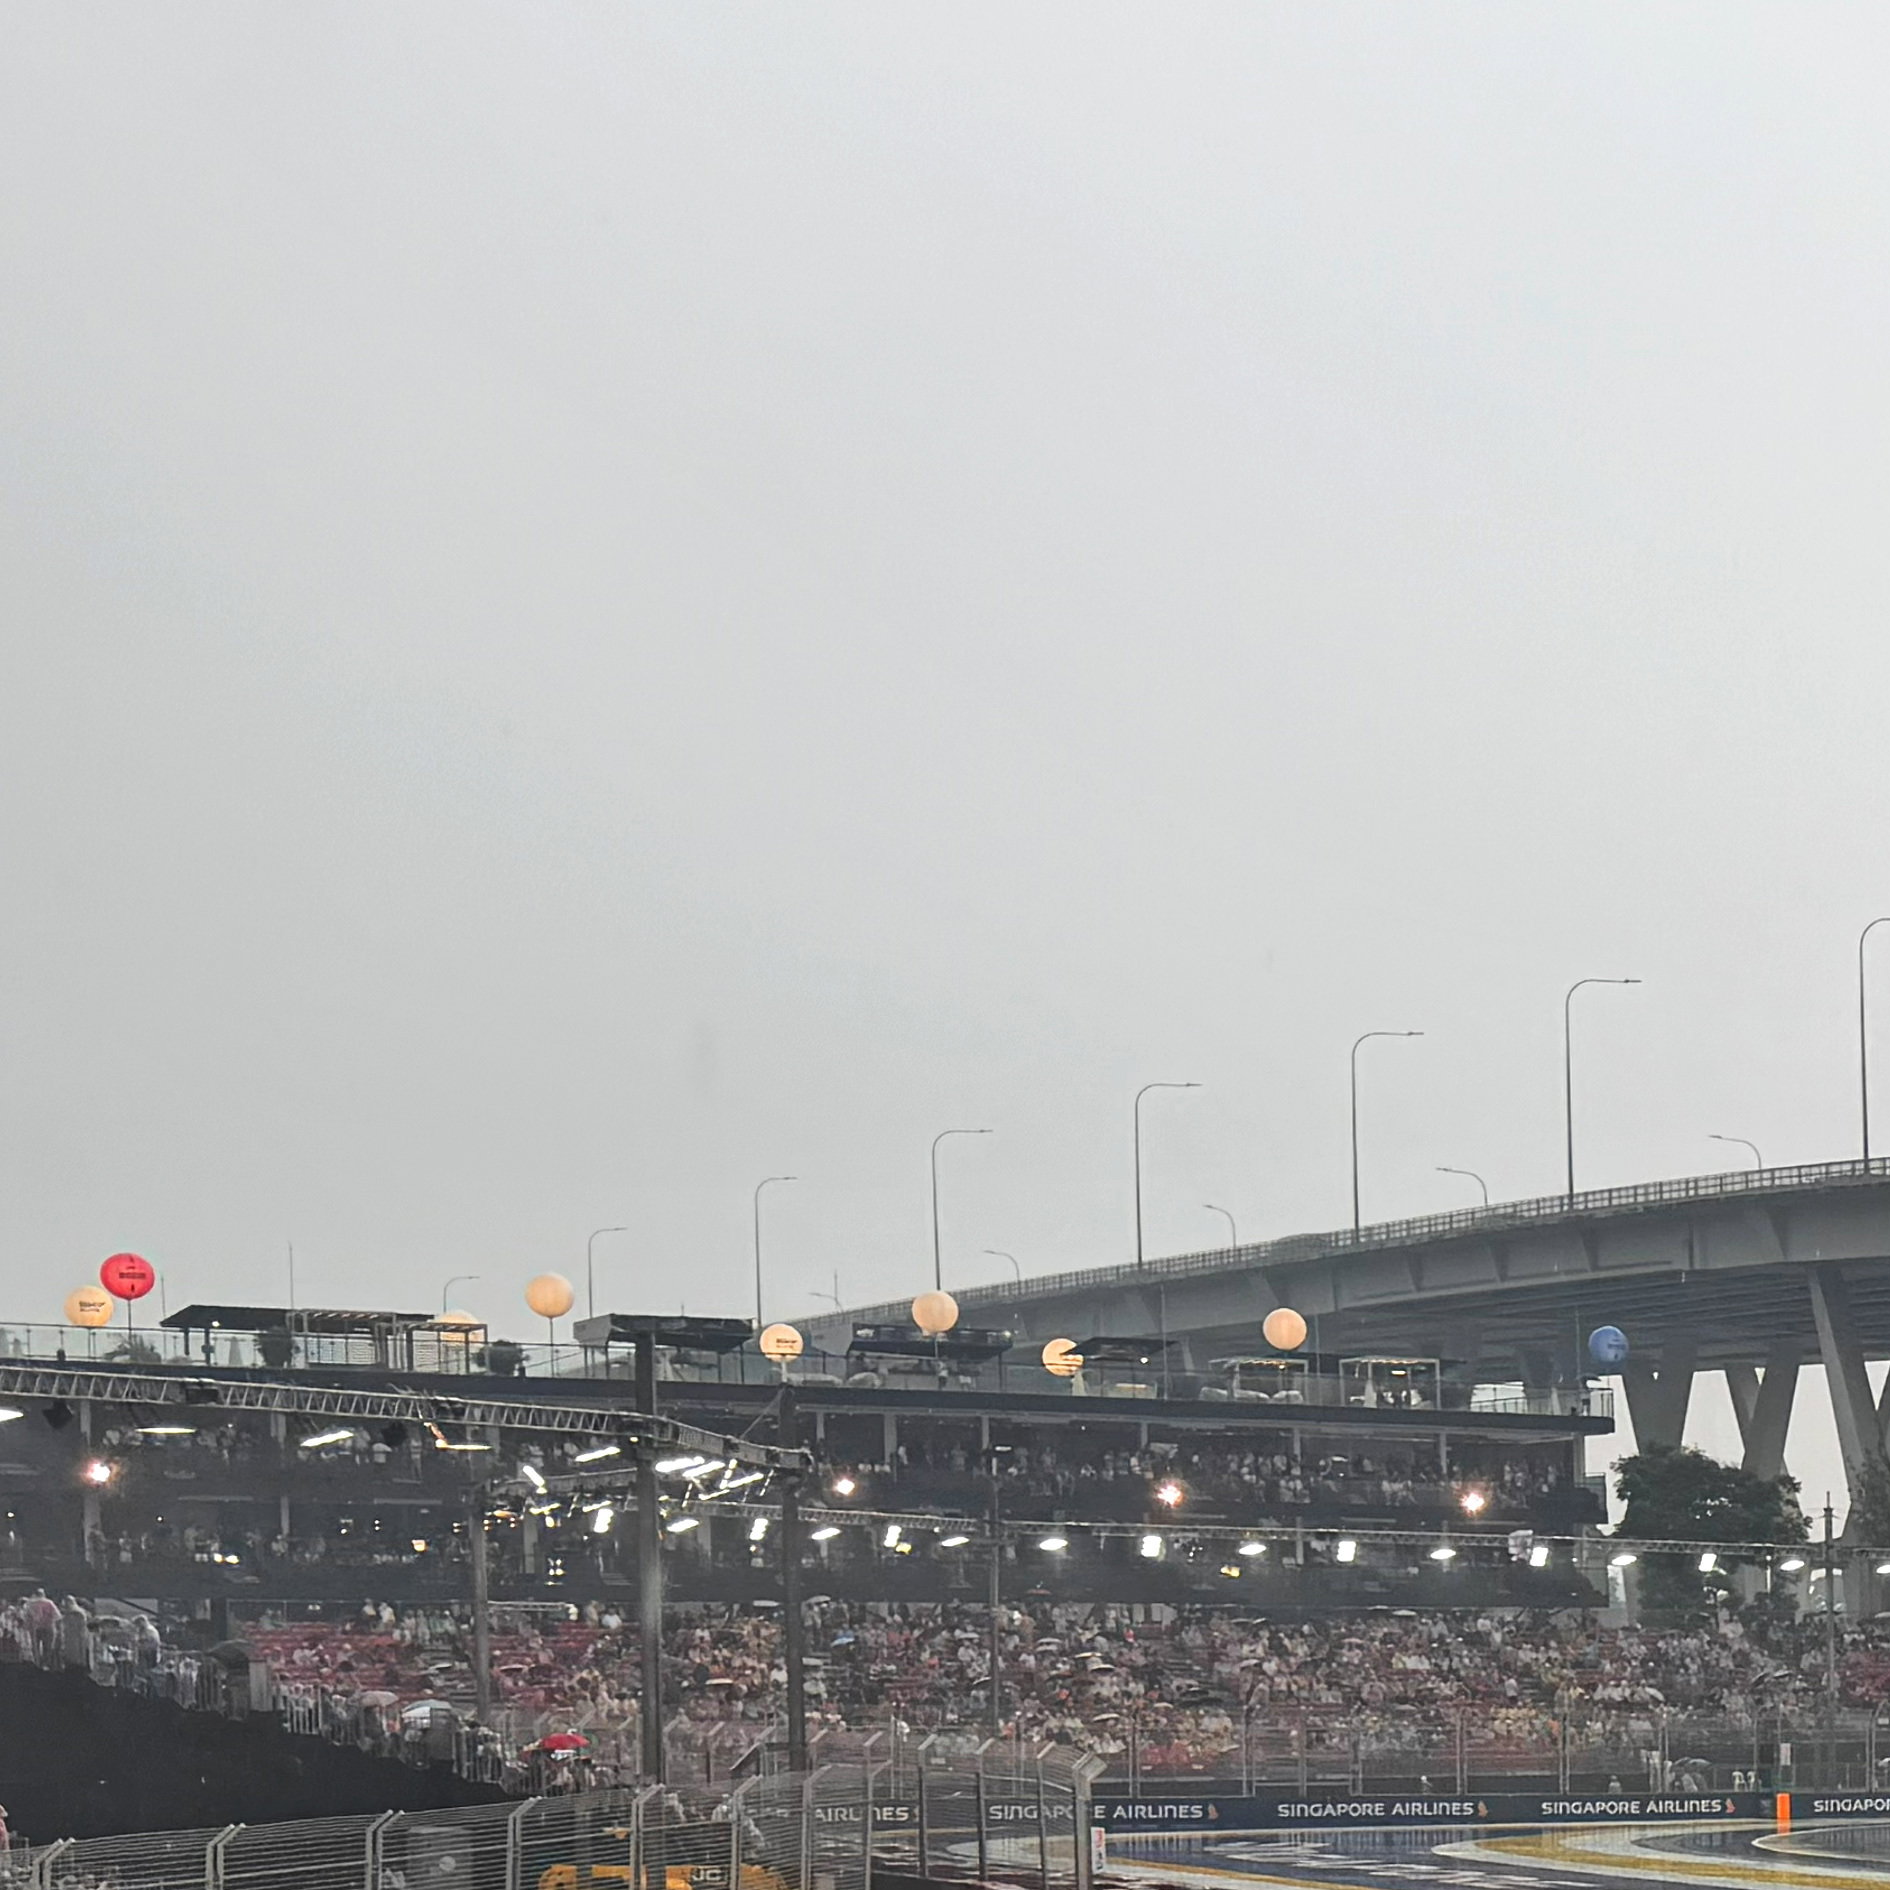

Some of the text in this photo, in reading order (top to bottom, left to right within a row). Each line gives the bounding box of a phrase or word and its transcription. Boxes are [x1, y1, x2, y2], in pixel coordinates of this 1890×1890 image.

[988, 1803, 1204, 1820] SINGAPOE AIRLINES
[1277, 1801, 1474, 1818] SINGAPORE AIRLINES
[1541, 1799, 1722, 1815] SINGAPORE AIRLINES
[692, 1866, 728, 1881] JC
